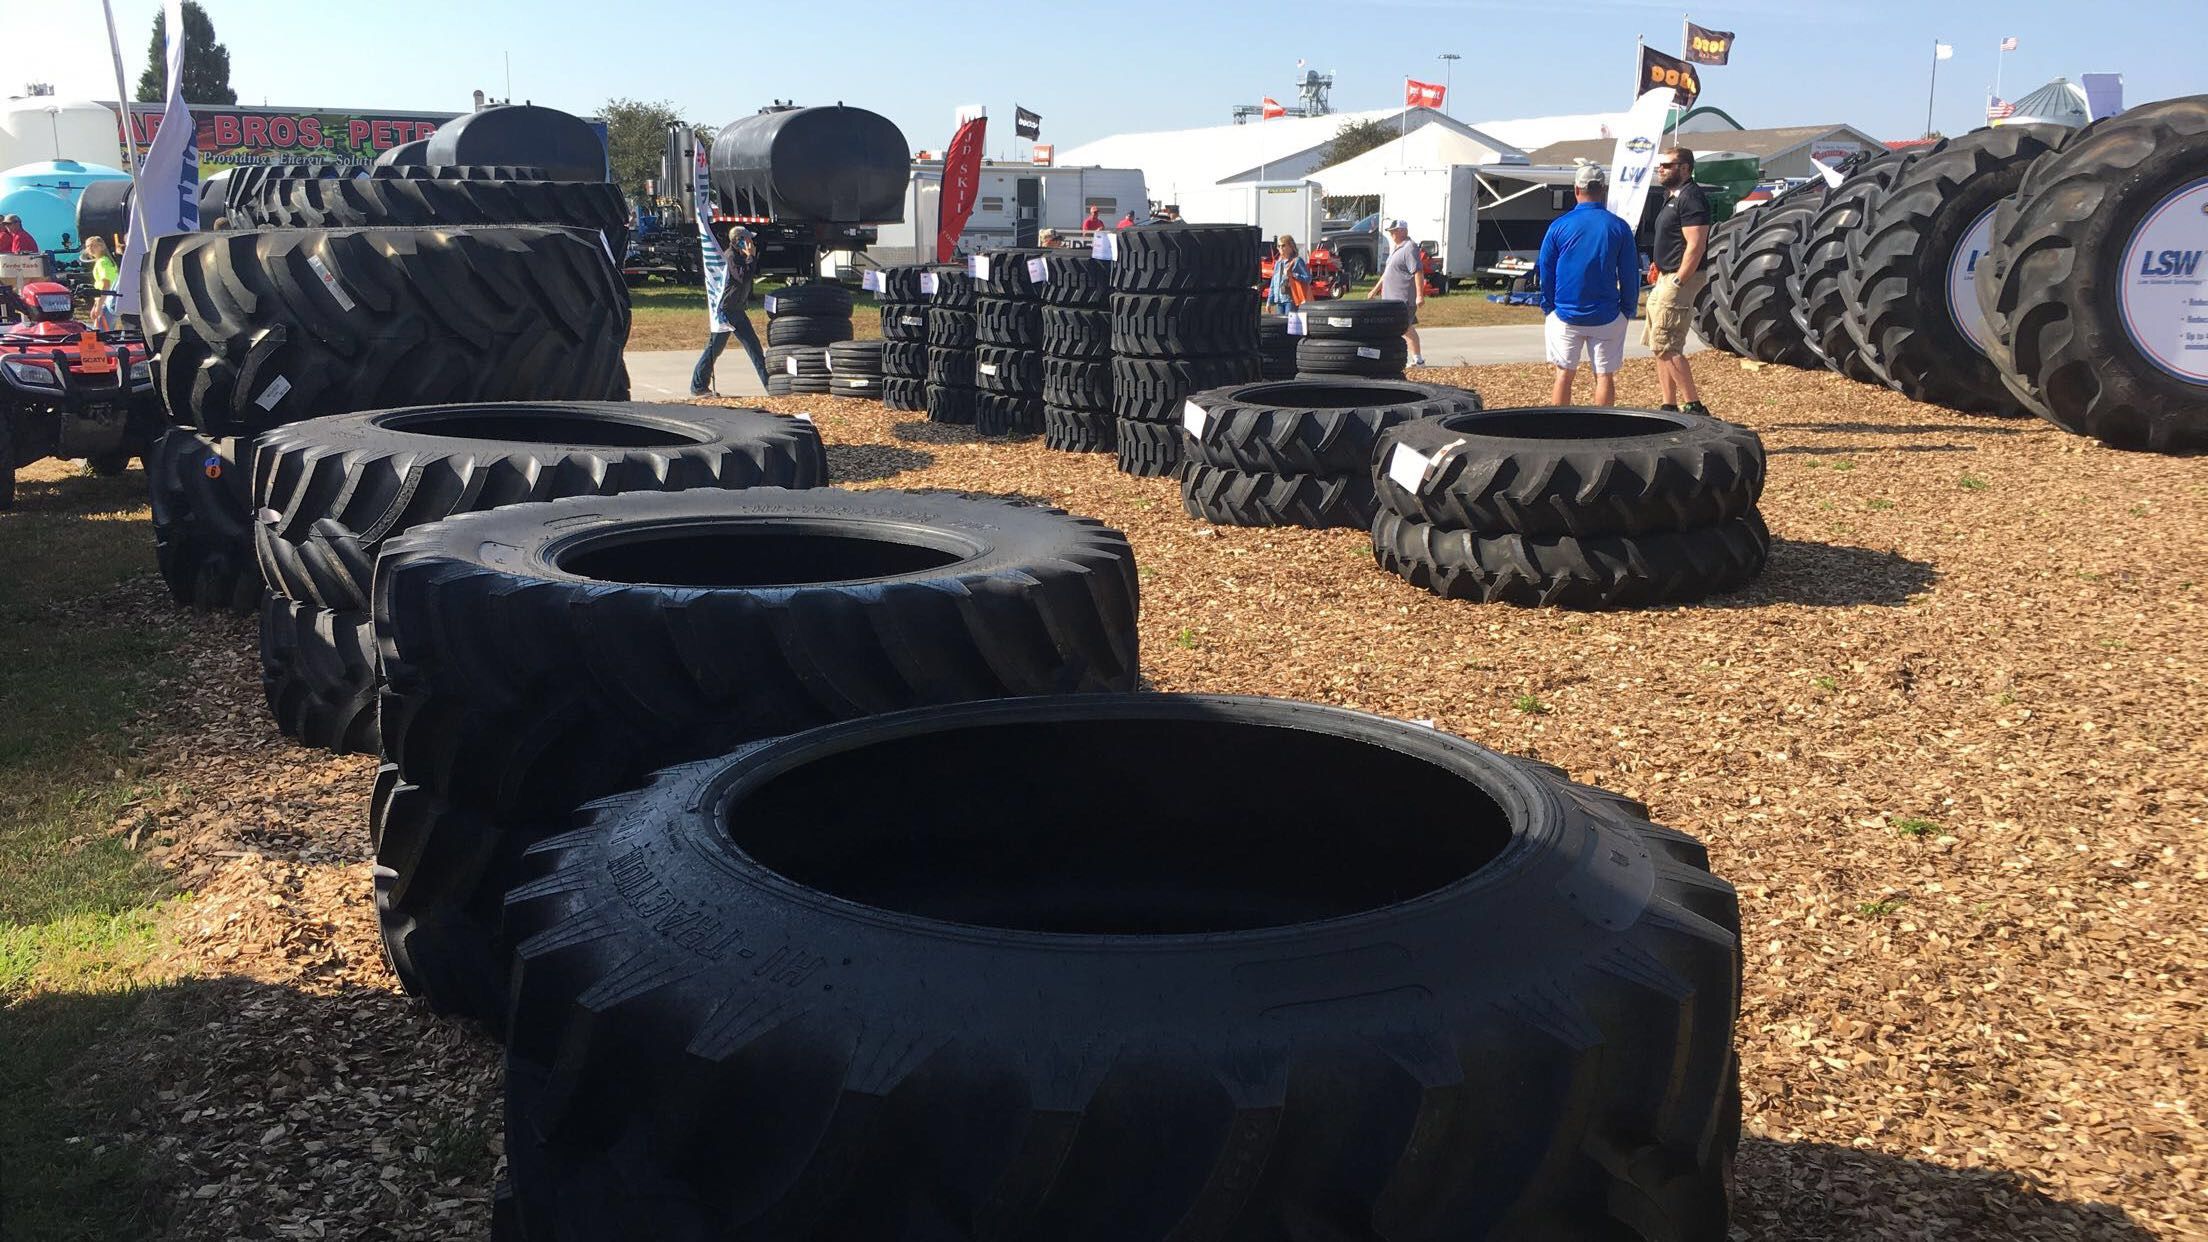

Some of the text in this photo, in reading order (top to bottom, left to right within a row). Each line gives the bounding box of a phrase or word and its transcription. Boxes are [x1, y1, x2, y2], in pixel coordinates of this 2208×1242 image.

[214, 115, 335, 149] BROS.
[279, 154, 324, 168] Energy
[335, 154, 376, 167] Soluti
[2140, 250, 2203, 276] LSW
